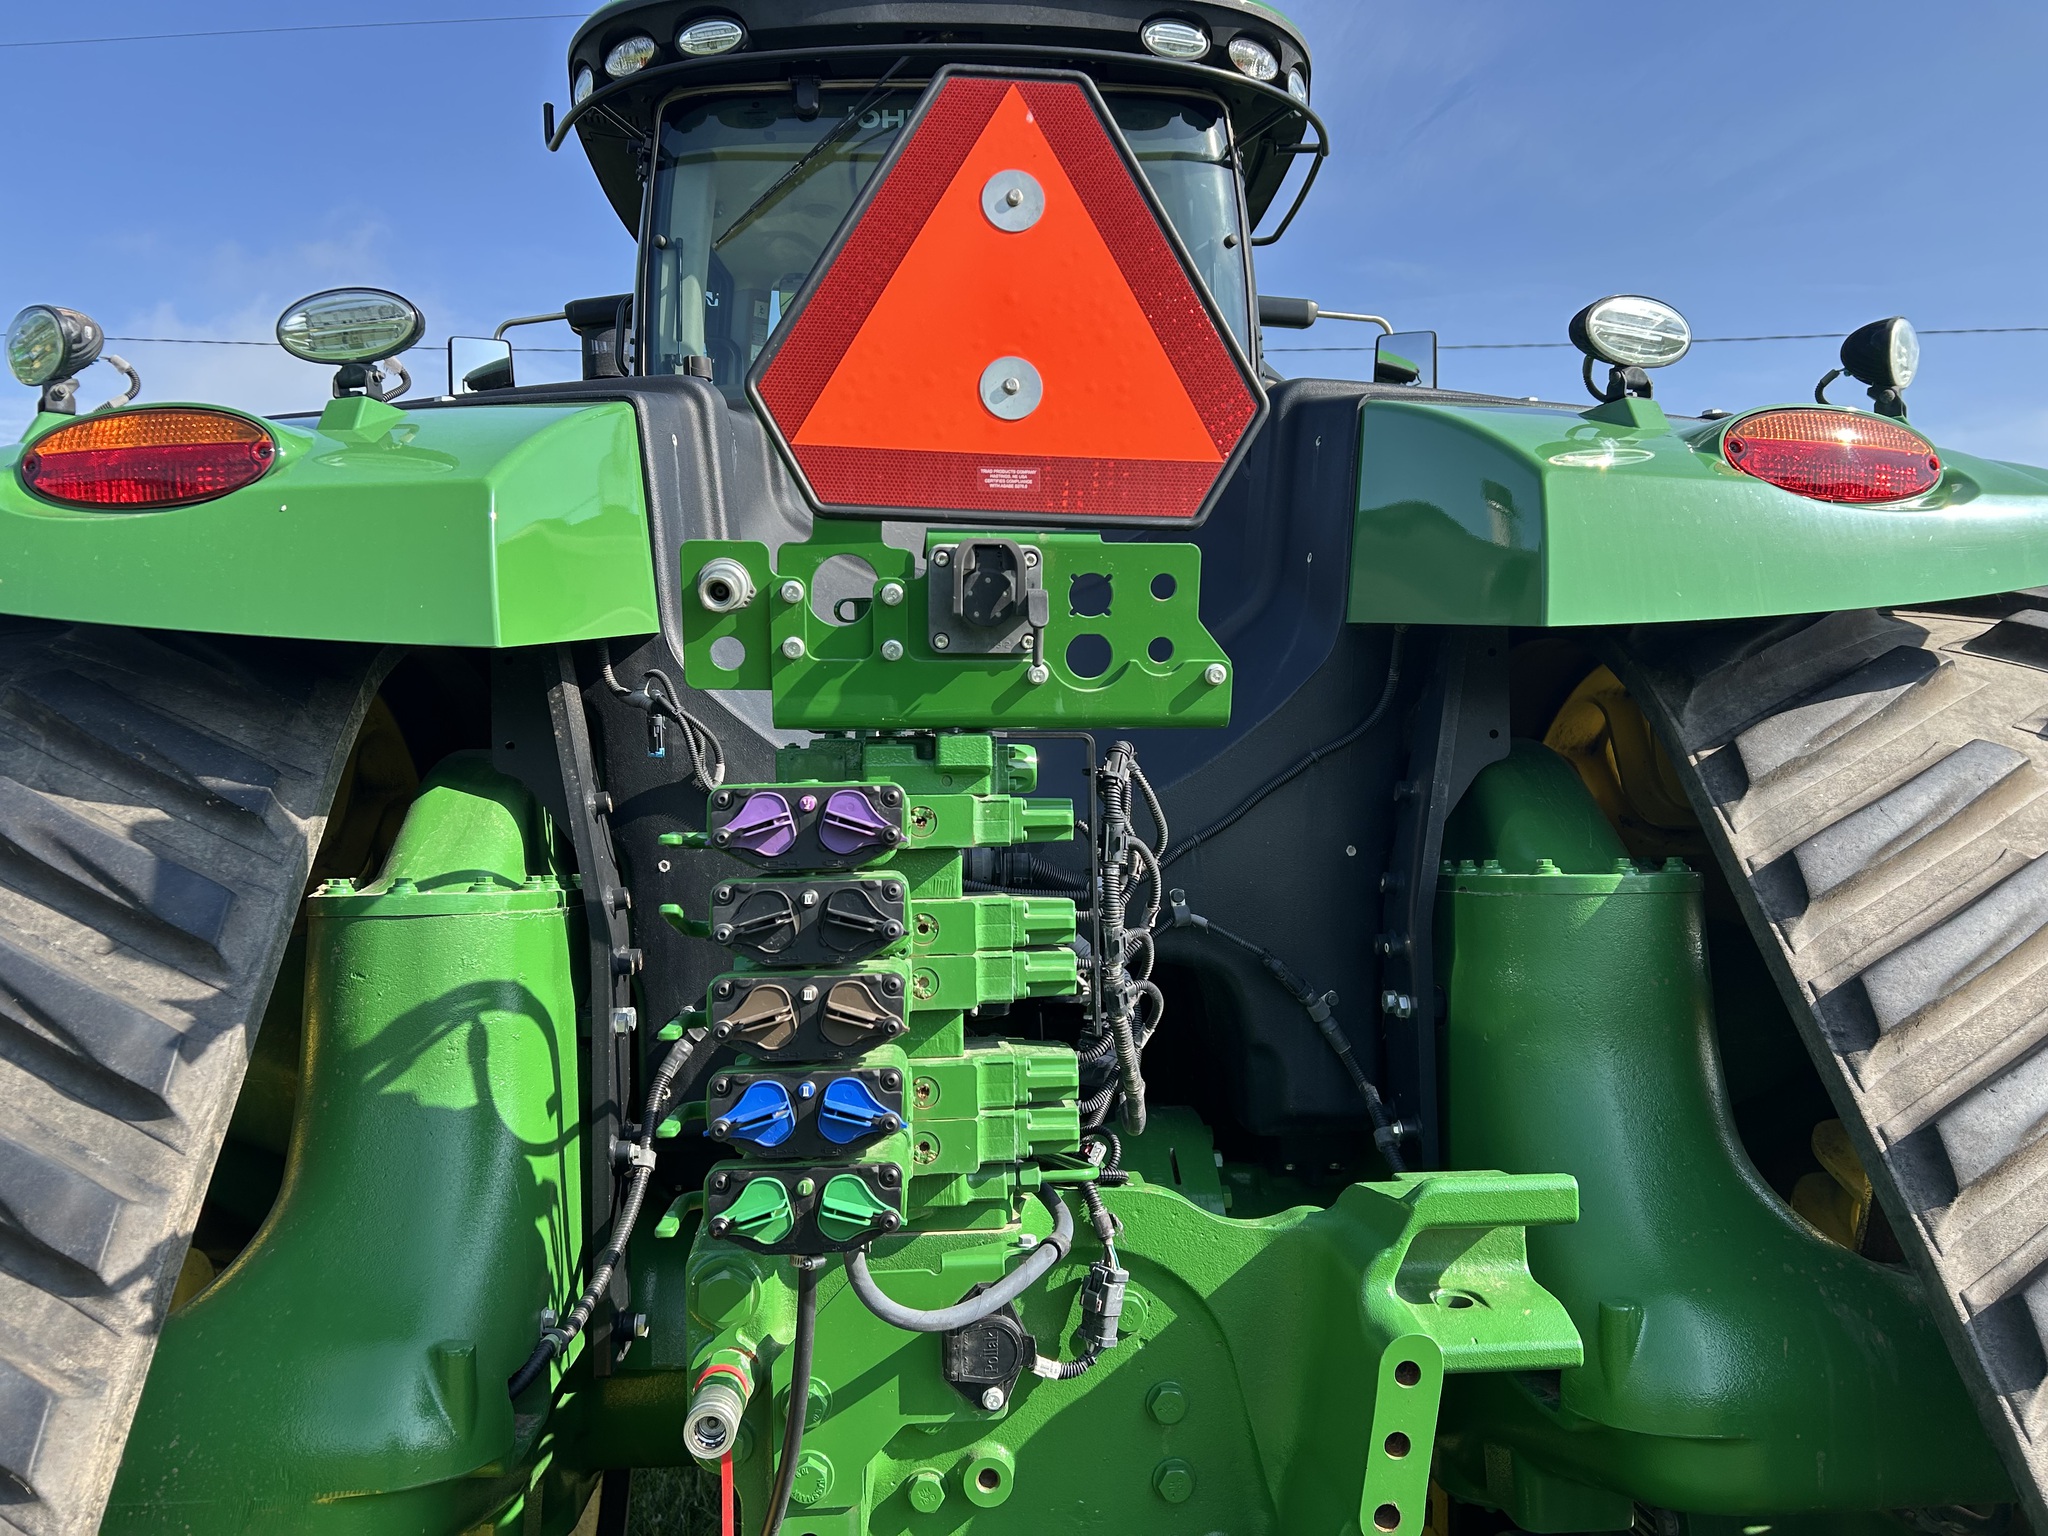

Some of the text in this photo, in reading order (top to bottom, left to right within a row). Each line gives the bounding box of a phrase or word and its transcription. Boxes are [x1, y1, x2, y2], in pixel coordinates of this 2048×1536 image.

[847, 106, 913, 129] OH
[803, 893, 813, 905] IV
[803, 989, 813, 1001] III
[984, 1329, 999, 1375] Pollak
